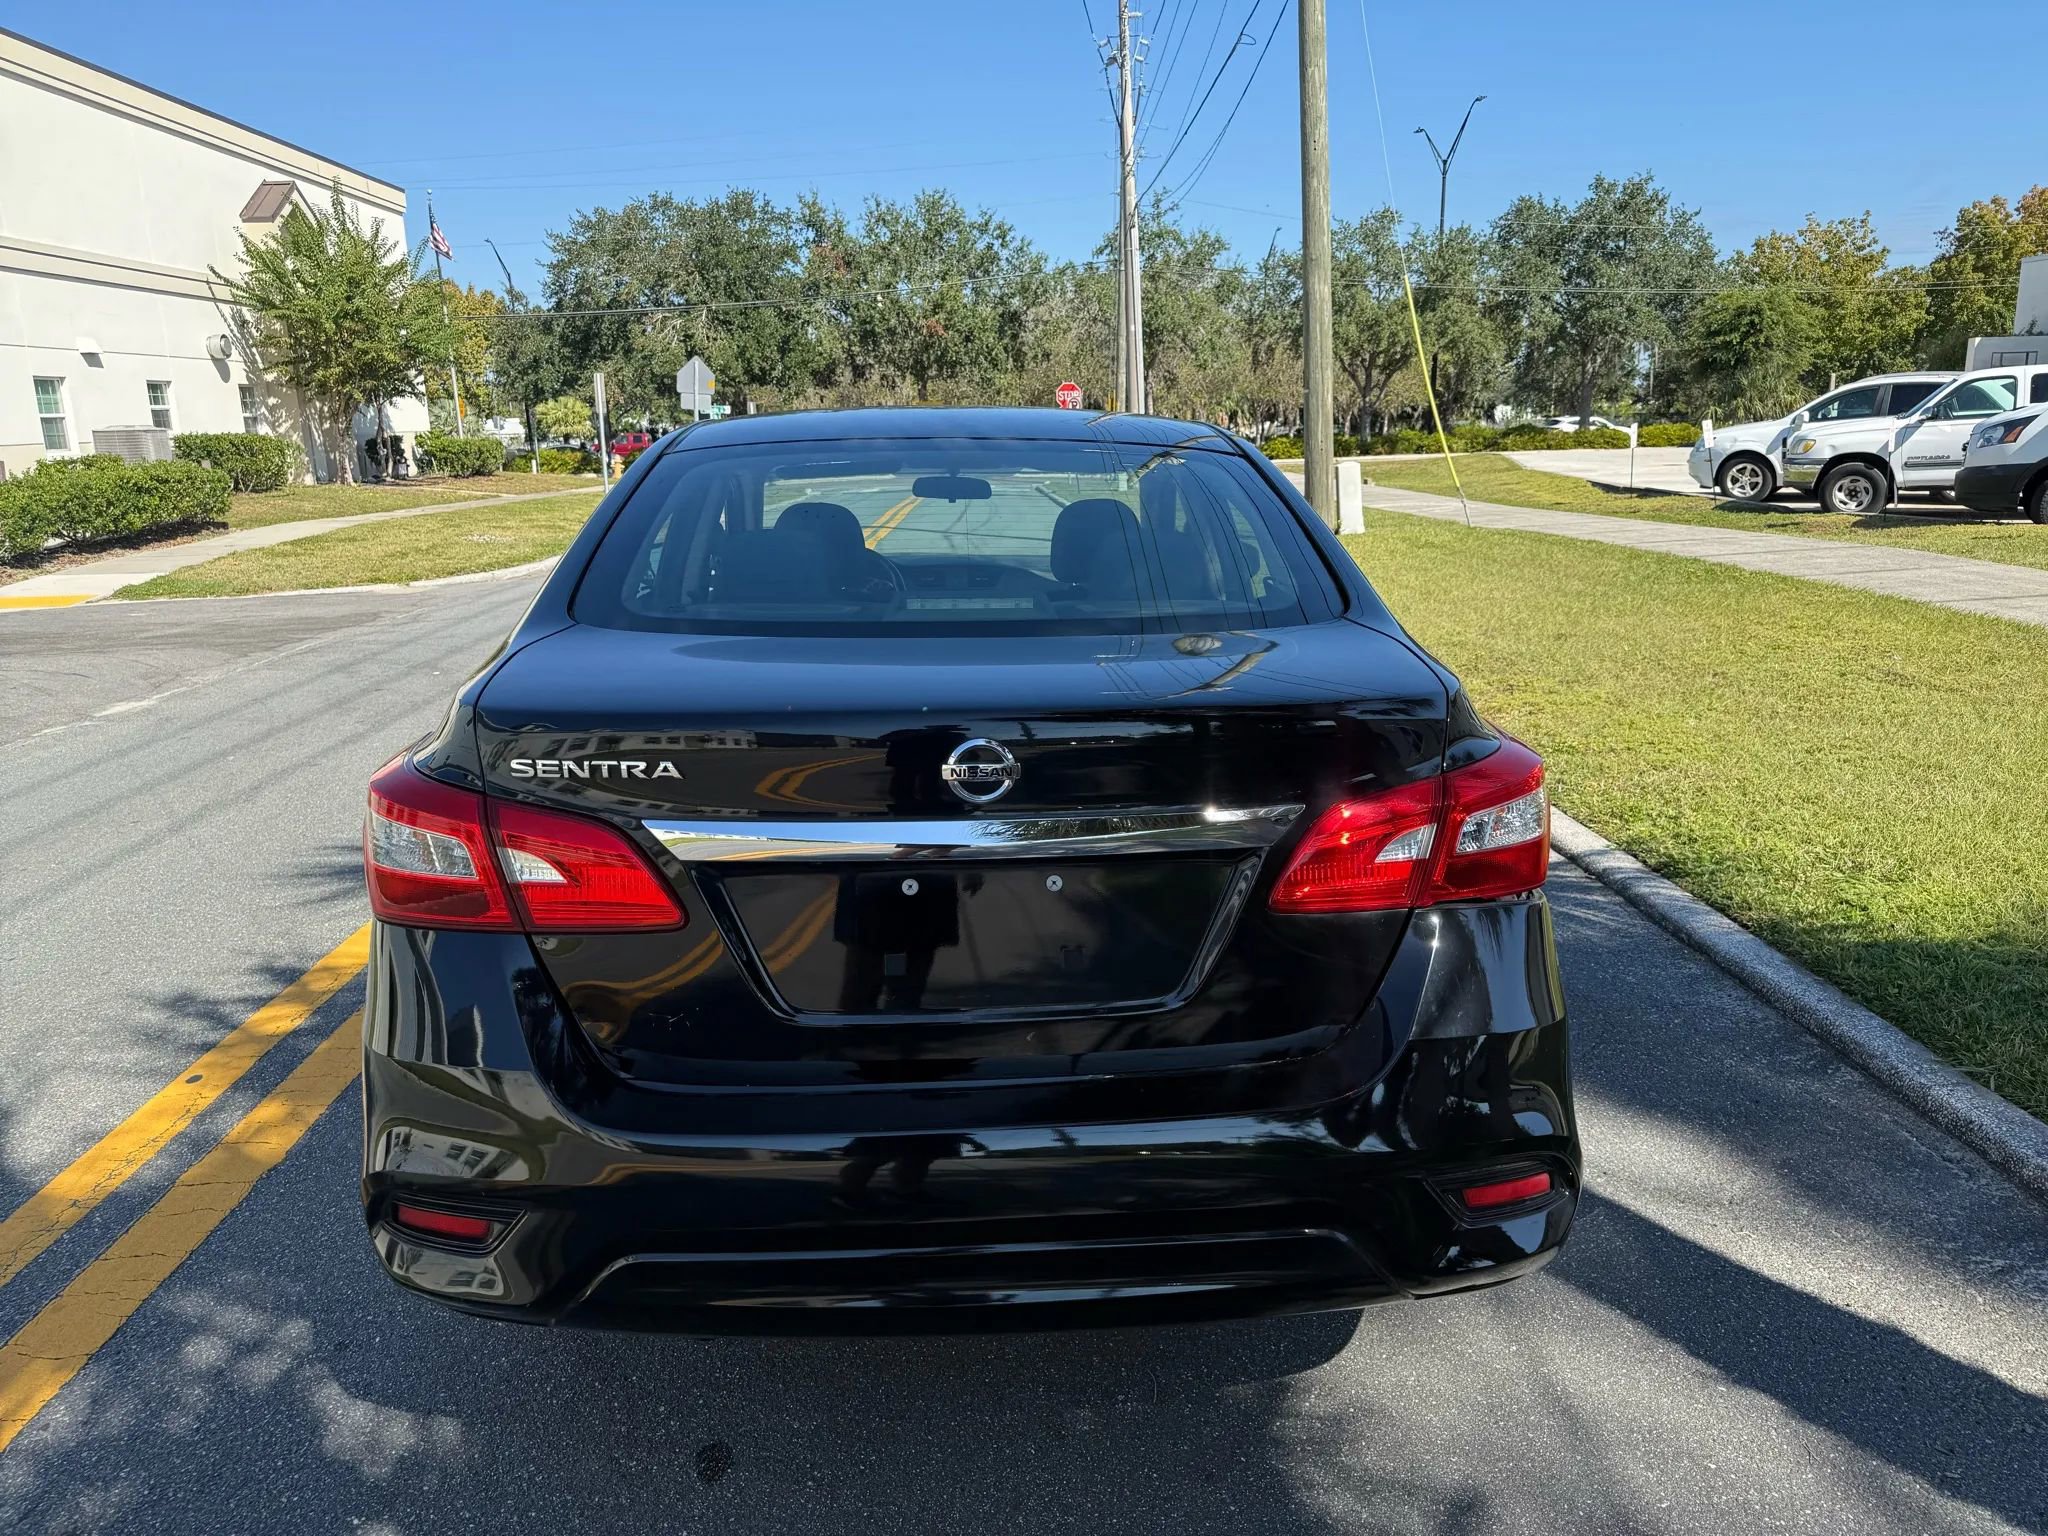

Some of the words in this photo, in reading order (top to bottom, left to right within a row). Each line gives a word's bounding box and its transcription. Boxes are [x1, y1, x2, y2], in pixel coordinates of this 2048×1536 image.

[1058, 390, 1078, 400] STOP
[510, 759, 684, 780] SENTRA
[950, 766, 1012, 778] NISSAN
